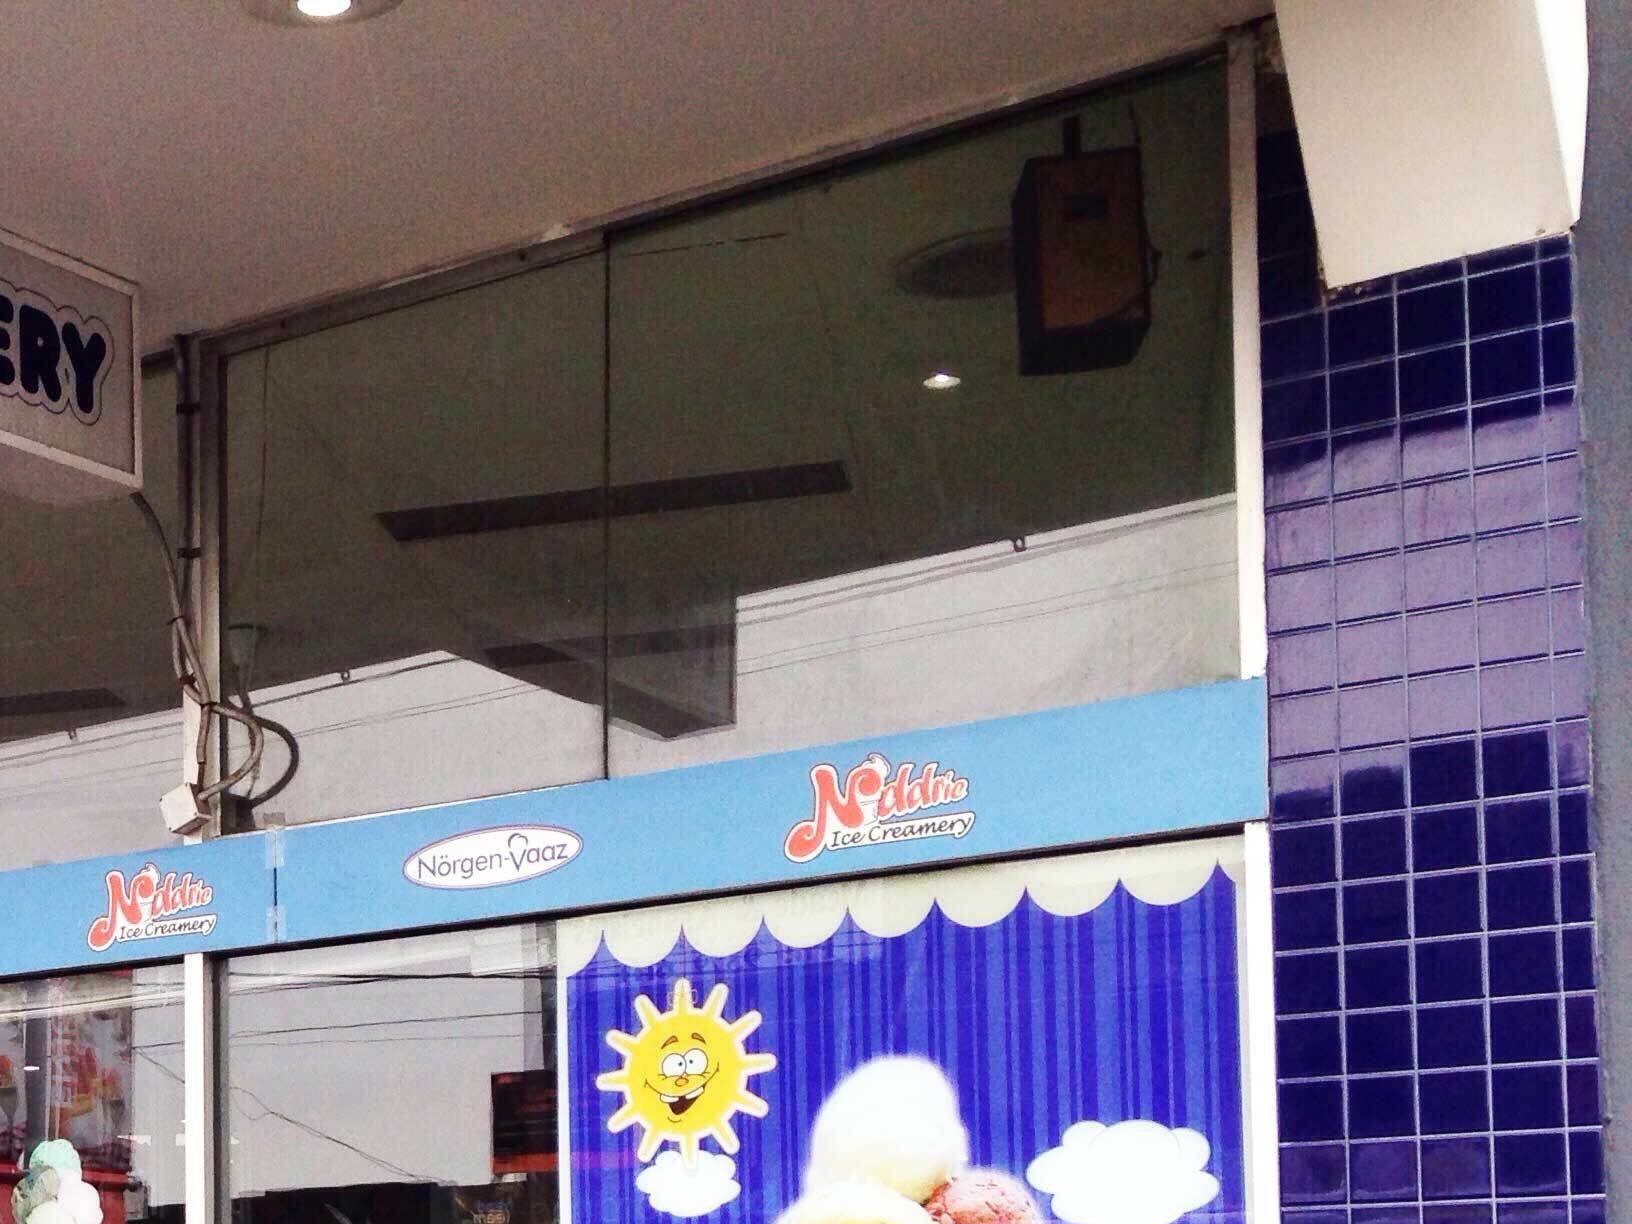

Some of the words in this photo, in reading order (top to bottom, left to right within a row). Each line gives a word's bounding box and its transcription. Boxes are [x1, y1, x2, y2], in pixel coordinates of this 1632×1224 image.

[787, 766, 968, 858] Niddrie
[830, 830, 866, 848] Ice
[868, 816, 972, 842] Creamery
[89, 872, 213, 949] Niddrie
[120, 926, 142, 941] Ice
[144, 918, 215, 935] Creamery
